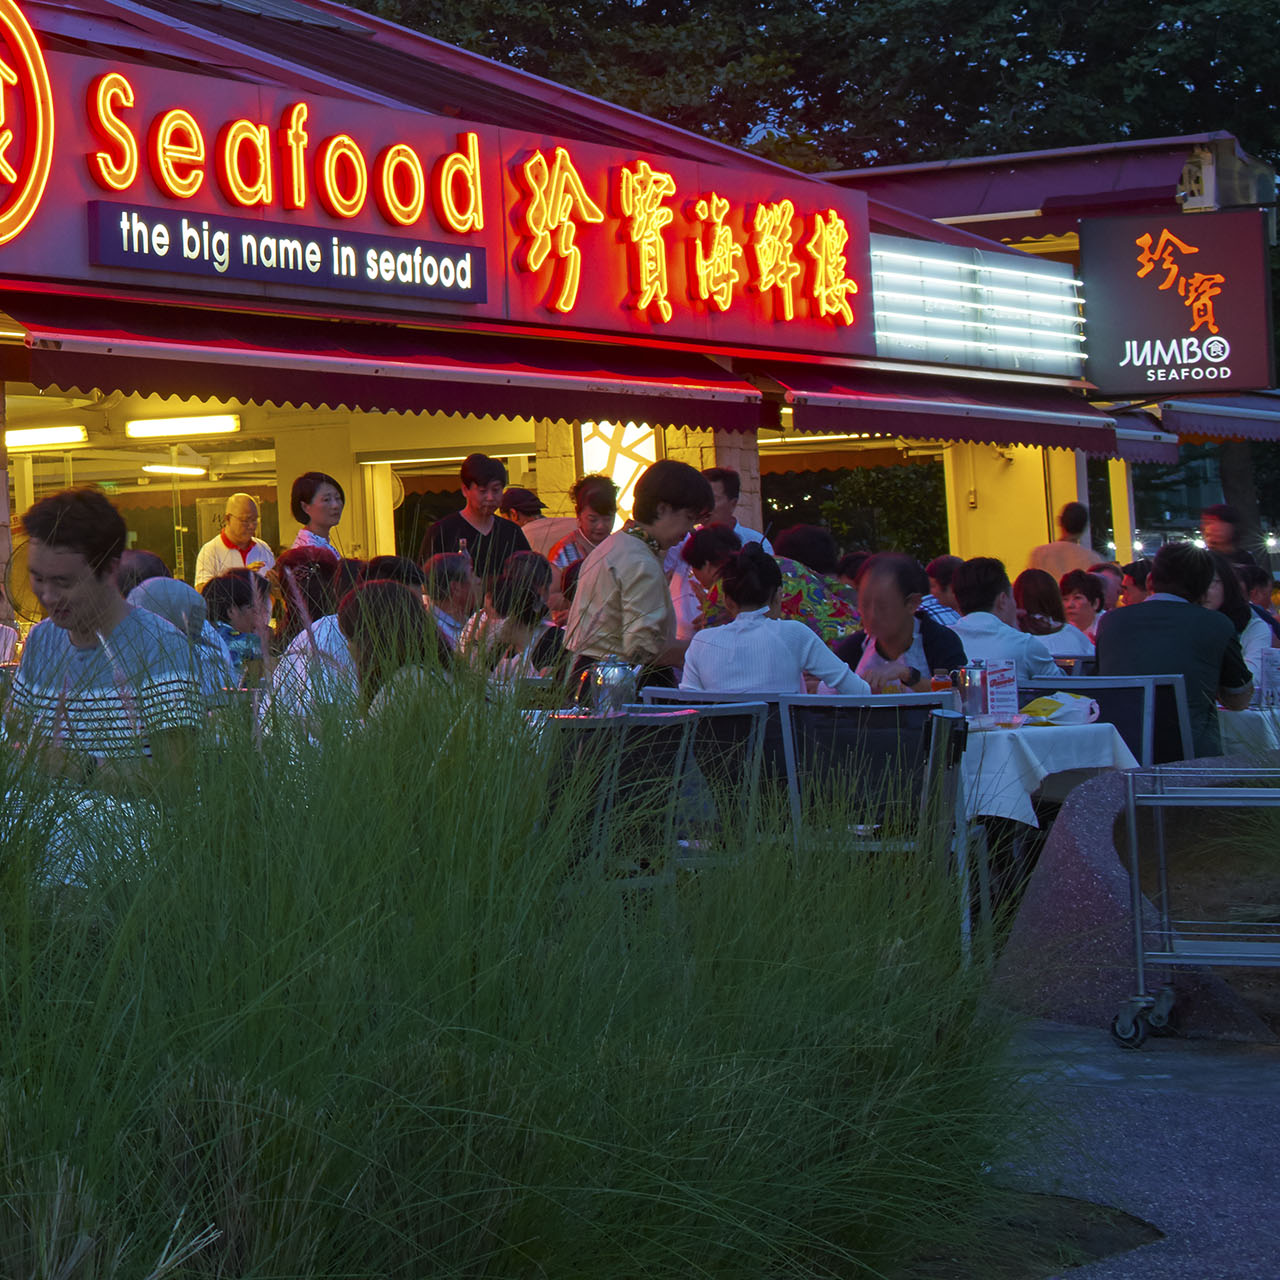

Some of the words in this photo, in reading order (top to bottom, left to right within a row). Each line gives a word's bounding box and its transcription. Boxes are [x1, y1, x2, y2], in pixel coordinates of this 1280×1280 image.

[88, 72, 484, 232] Seafood
[120, 211, 170, 256] the
[181, 218, 230, 273] big
[241, 234, 322, 274] name
[332, 236, 357, 277] in
[366, 246, 472, 289] seafood
[1119, 336, 1231, 367] JUMBO
[1146, 367, 1232, 382] SEAFOOD
